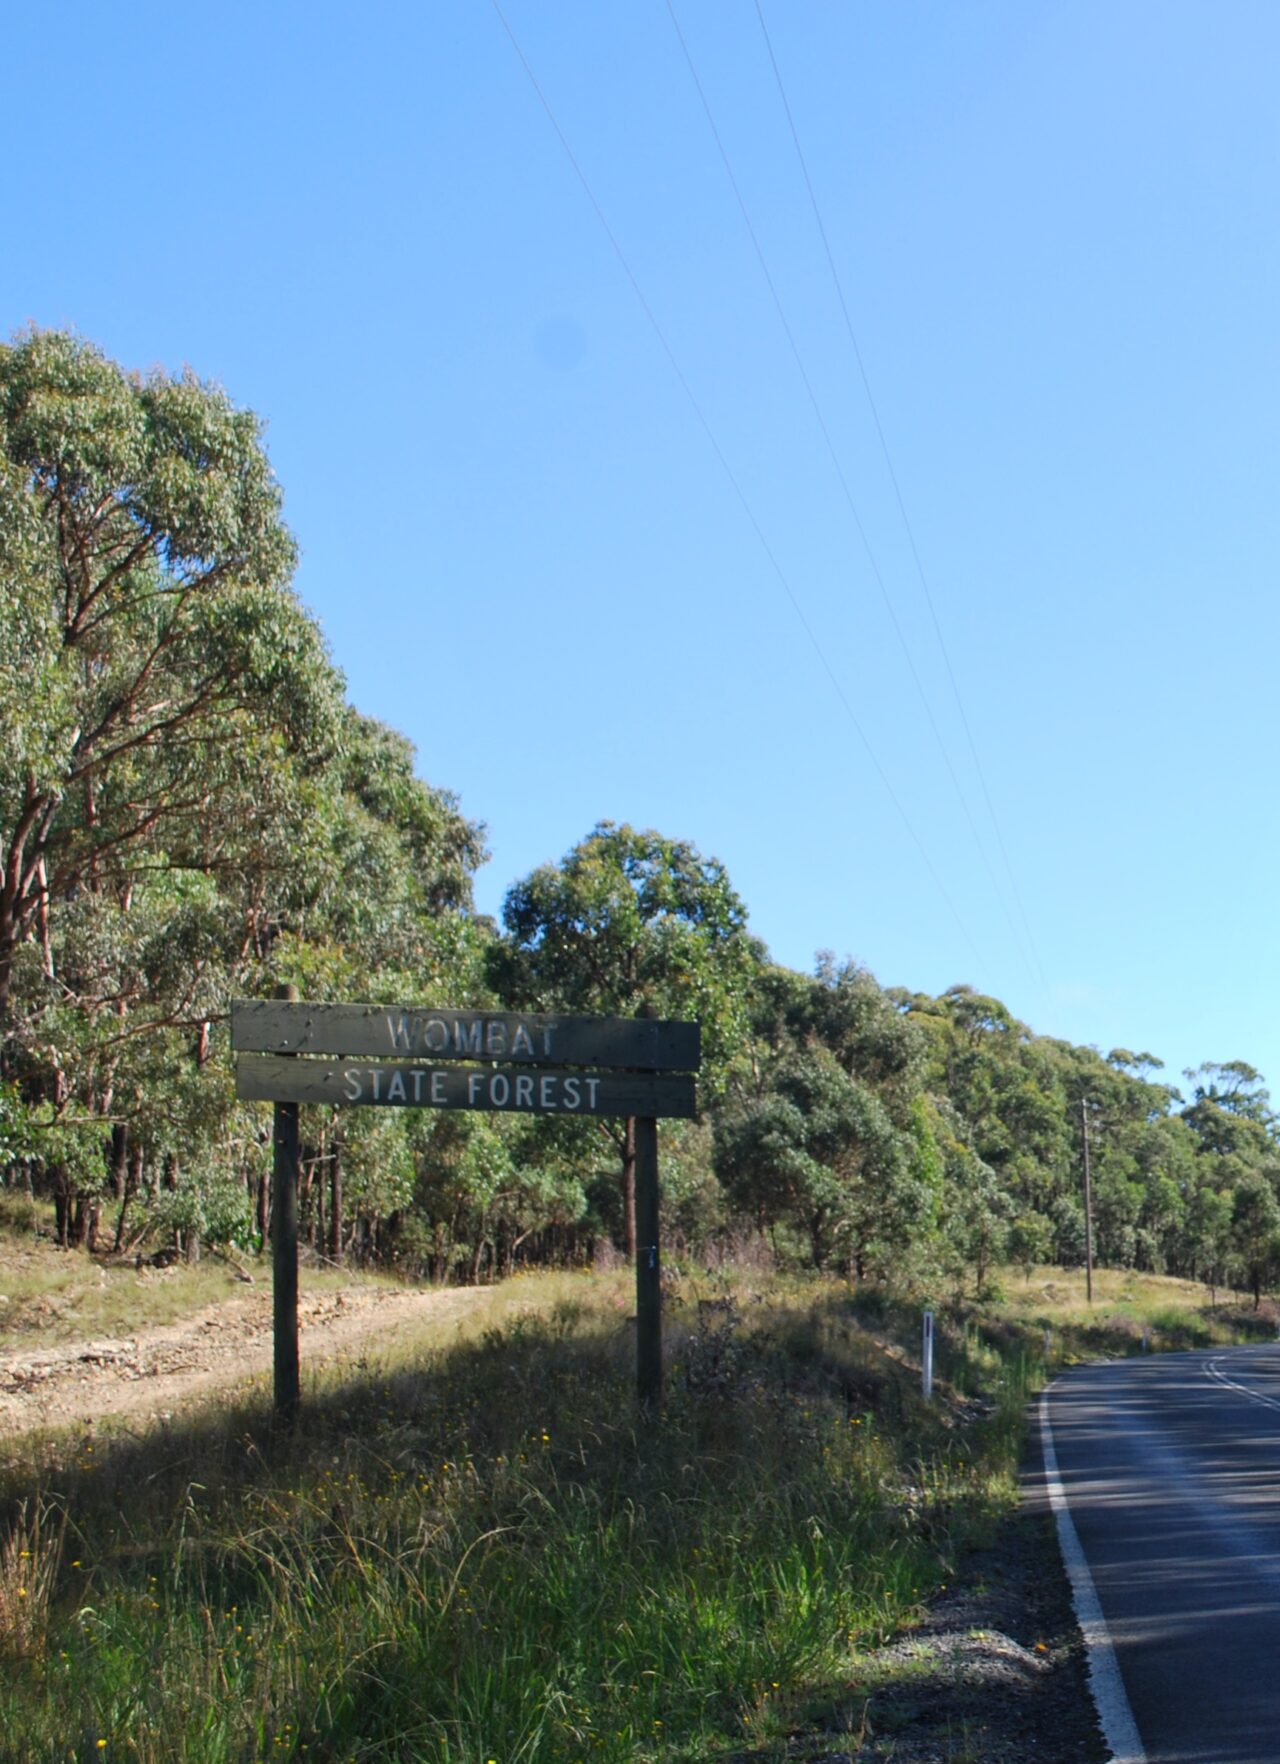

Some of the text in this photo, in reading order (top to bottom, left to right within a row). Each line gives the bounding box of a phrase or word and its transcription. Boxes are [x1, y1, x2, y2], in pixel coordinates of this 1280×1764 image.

[387, 1015, 557, 1056] WOMBAT
[343, 1068, 600, 1109] STATE FOREST
